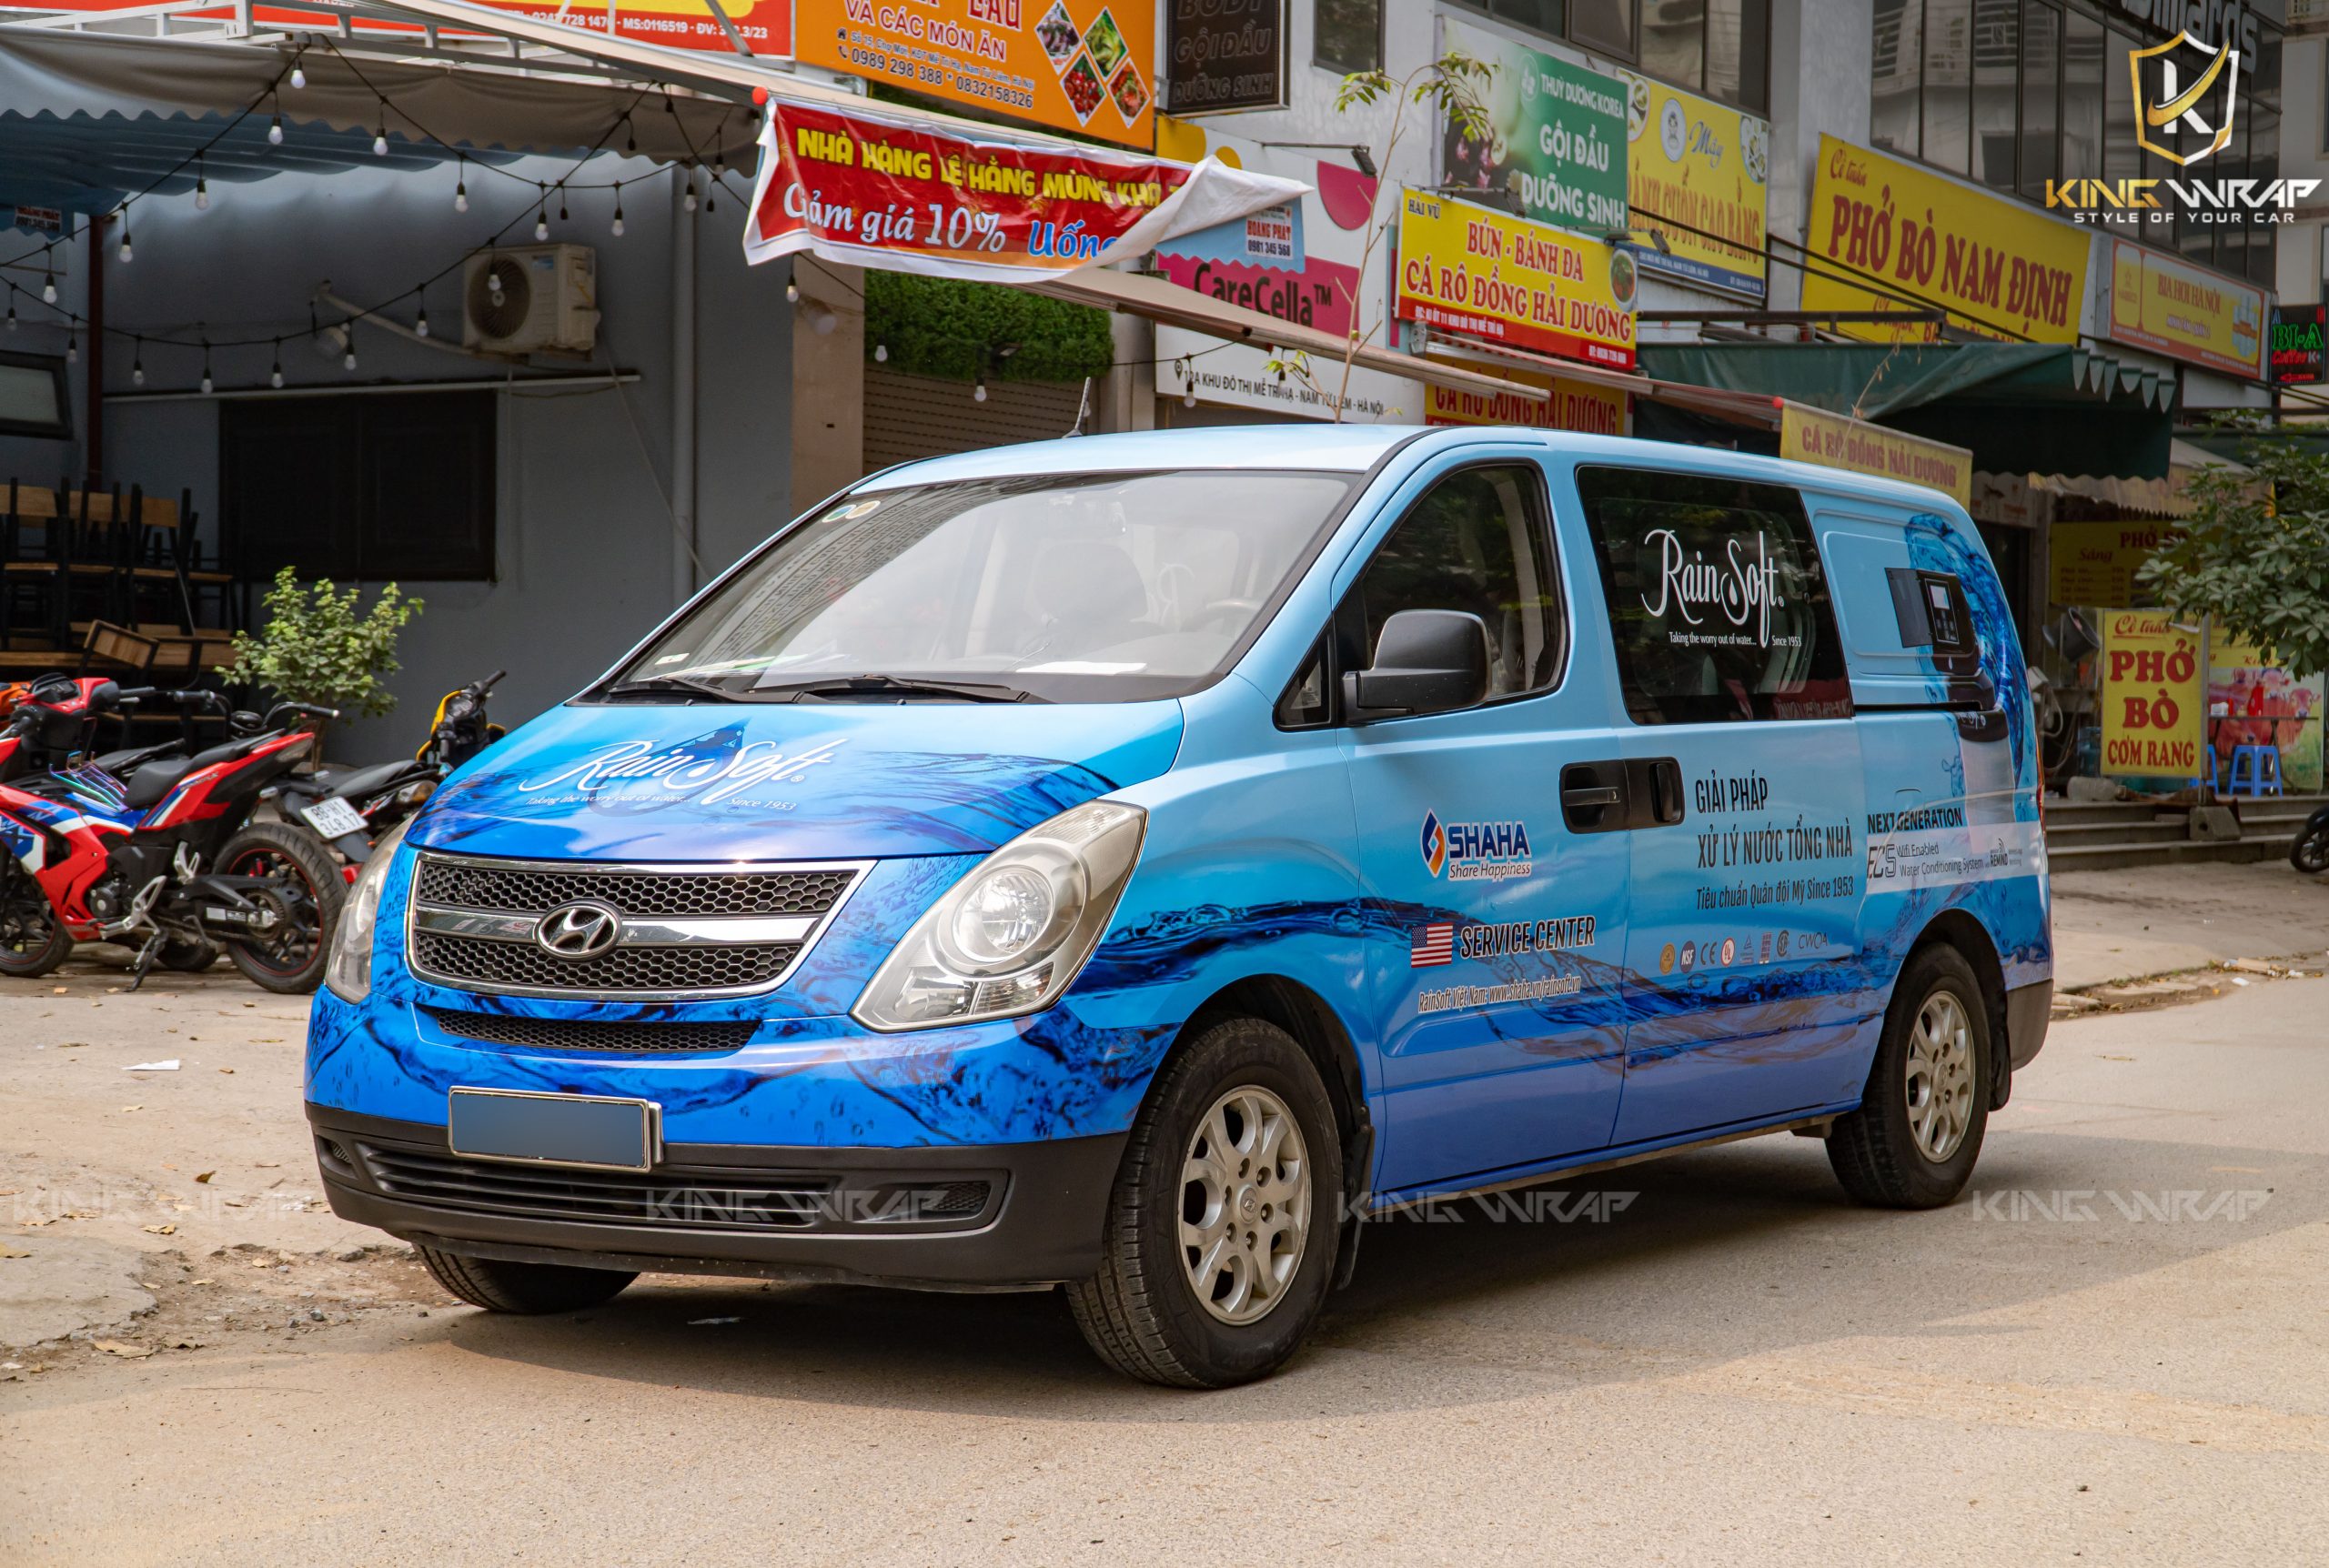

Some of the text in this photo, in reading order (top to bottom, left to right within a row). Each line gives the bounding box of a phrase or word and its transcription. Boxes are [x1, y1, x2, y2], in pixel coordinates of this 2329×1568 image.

[879, 5, 1006, 63] CÁC MÓN ĂN
[852, 47, 1033, 108] 0989 298 388 0832158326
[1597, 94, 1625, 120] KOREA
[797, 127, 853, 165] NHÀ
[861, 137, 932, 180] HÀNG
[1539, 119, 1609, 172] GỘI ĐẦU
[1521, 173, 1626, 227] DƯỠNG SINH
[861, 203, 915, 243] giá
[924, 203, 1006, 253] 10%
[1467, 217, 1585, 283] BÚN BÁNH ĐA
[1828, 184, 1894, 273] PHỞ
[1895, 208, 1937, 286] BÒ
[1941, 233, 2005, 309] NAM
[2006, 256, 2072, 335] ĐỊNH
[1406, 255, 1631, 343] CÁ RÔ ĐỒNG HẢI DƯƠNG
[1203, 373, 1222, 388] KHU
[1801, 425, 1821, 455] CÁ
[1669, 631, 1689, 647] Taking
[1689, 632, 1699, 643] the
[1700, 635, 1717, 647] worry
[1718, 636, 1728, 645] out
[1729, 633, 1736, 644] of
[1772, 635, 1787, 646] Since
[1788, 637, 1802, 647] 1953
[2109, 638, 2196, 683] PHỞ
[2122, 689, 2179, 729] BÒ
[2108, 735, 2194, 768] CƠM RANG
[525, 797, 562, 808] Taking
[563, 794, 585, 804] the
[587, 795, 615, 806] worry
[615, 795, 631, 803] out
[632, 793, 650, 803] of
[730, 797, 761, 809] Since
[763, 799, 797, 810] 1953
[1695, 769, 1768, 813] GIẢI PHÁP
[1447, 822, 1530, 858] SHAHA
[1698, 814, 1852, 868] XỬ LÝ NƯỚC TỔNG NHÀ
[1868, 808, 1963, 834] NEXT GENERATION
[1896, 843, 1939, 856] Wifi Enabled
[1900, 863, 1920, 878] Water
[1921, 859, 1961, 874] Conditioning
[1962, 859, 1983, 873] System
[1450, 862, 1530, 880] Share Happiness
[1697, 876, 1854, 910] Tiêu chuẩn Quân đội Mỹ Since 1953
[1461, 917, 1595, 958] SERVICE CENTER
[1419, 974, 1581, 1012] RainSoft Việt Nam: www.shaha.vn/rainsoft.vn
